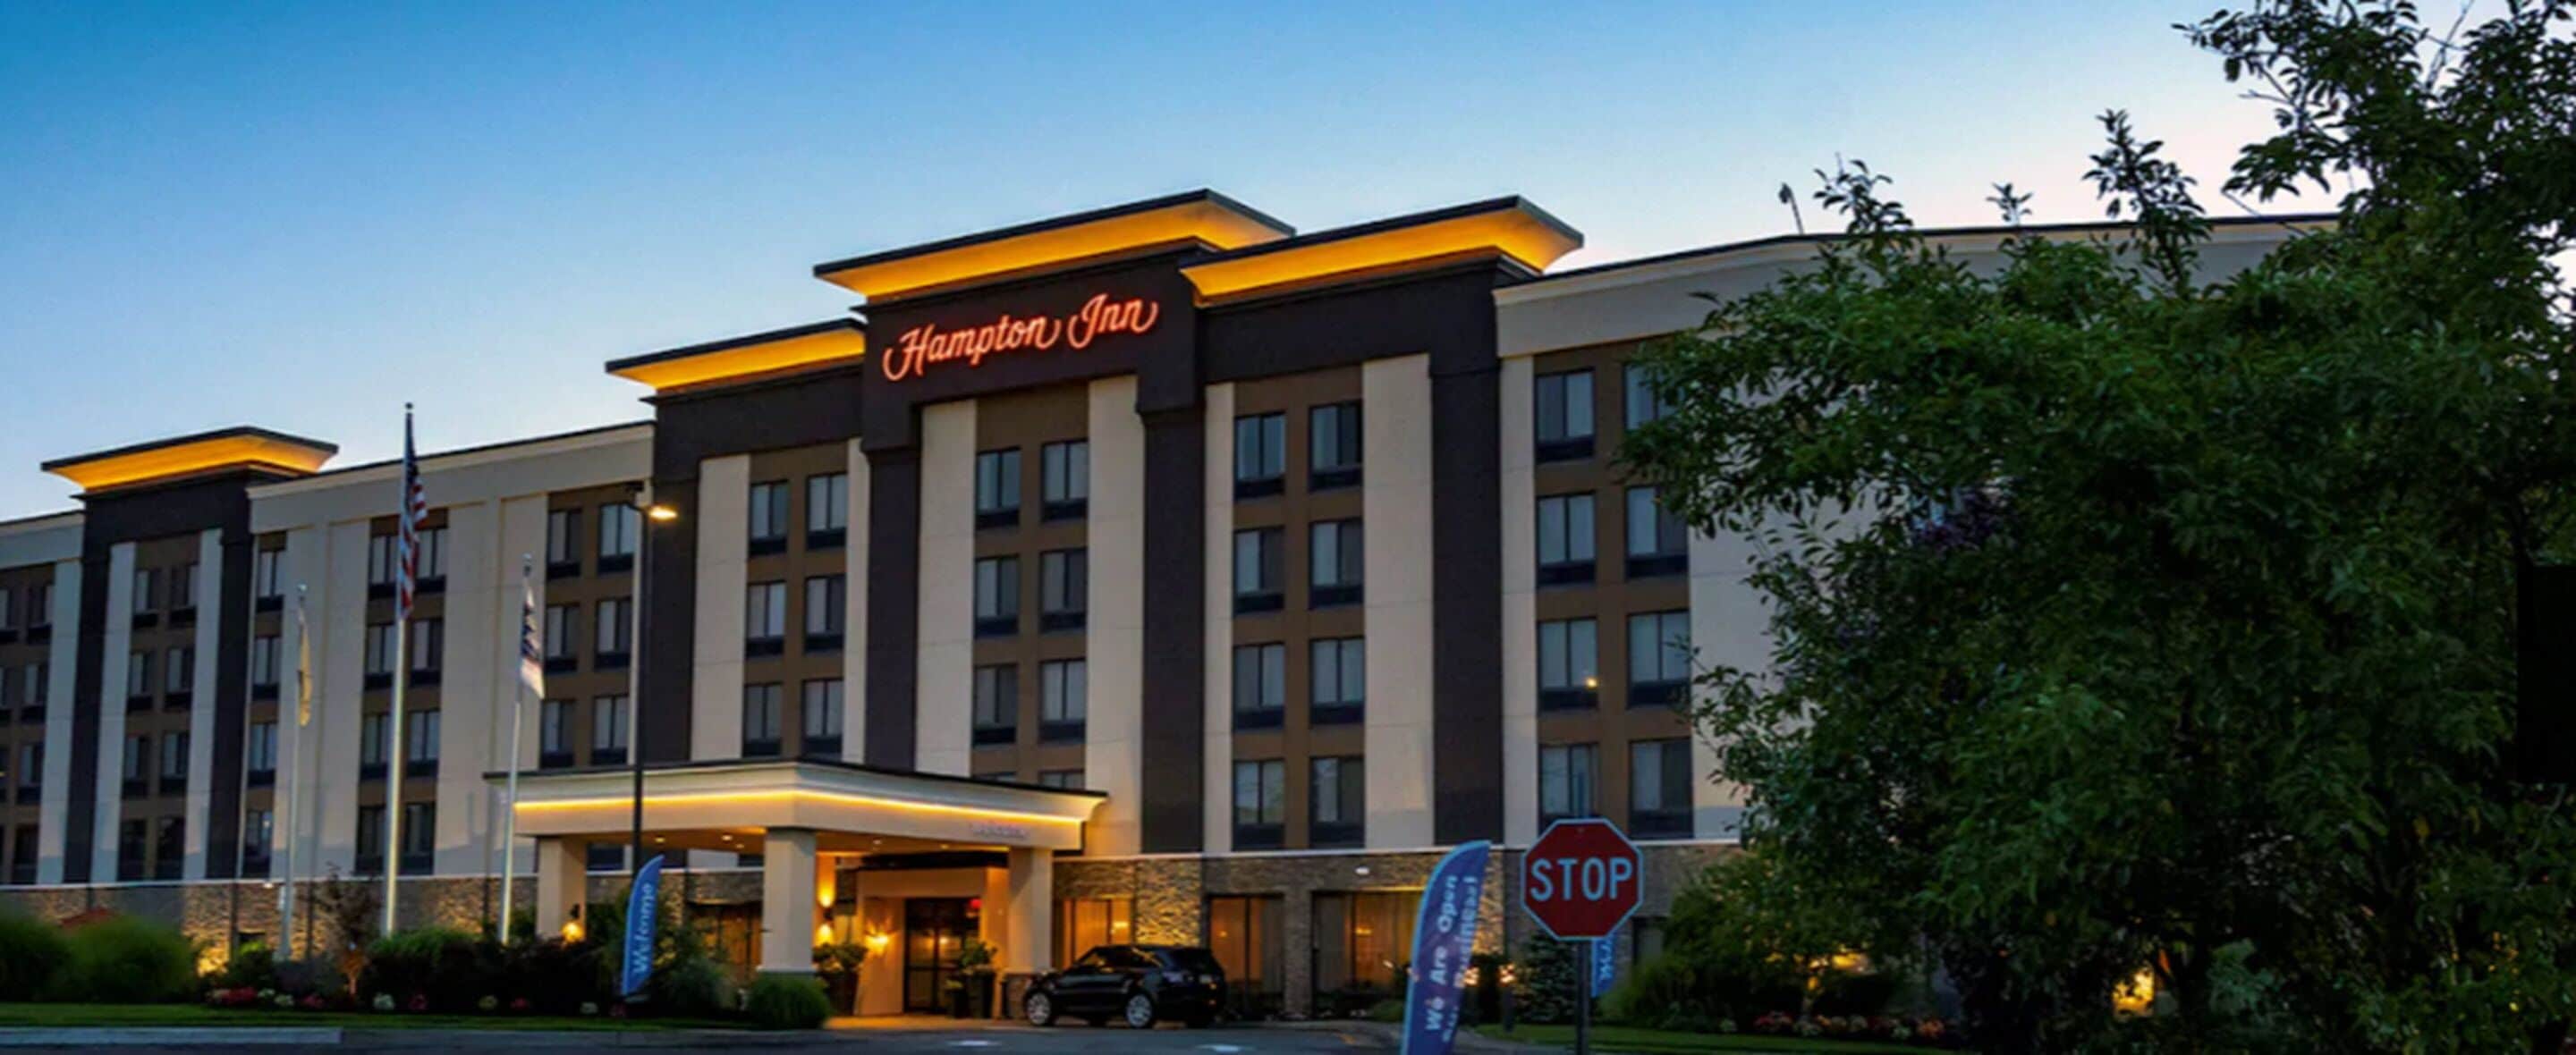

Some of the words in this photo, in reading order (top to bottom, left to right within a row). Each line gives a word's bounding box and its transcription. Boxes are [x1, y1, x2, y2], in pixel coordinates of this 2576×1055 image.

[882, 315, 1062, 382] Hampton
[1067, 292, 1159, 350] Inn
[1436, 875, 1458, 933] Open
[1530, 856, 1633, 902] STOP
[632, 882, 655, 973] Welcome
[1429, 946, 1447, 985] Are
[1426, 996, 1445, 1030] We
